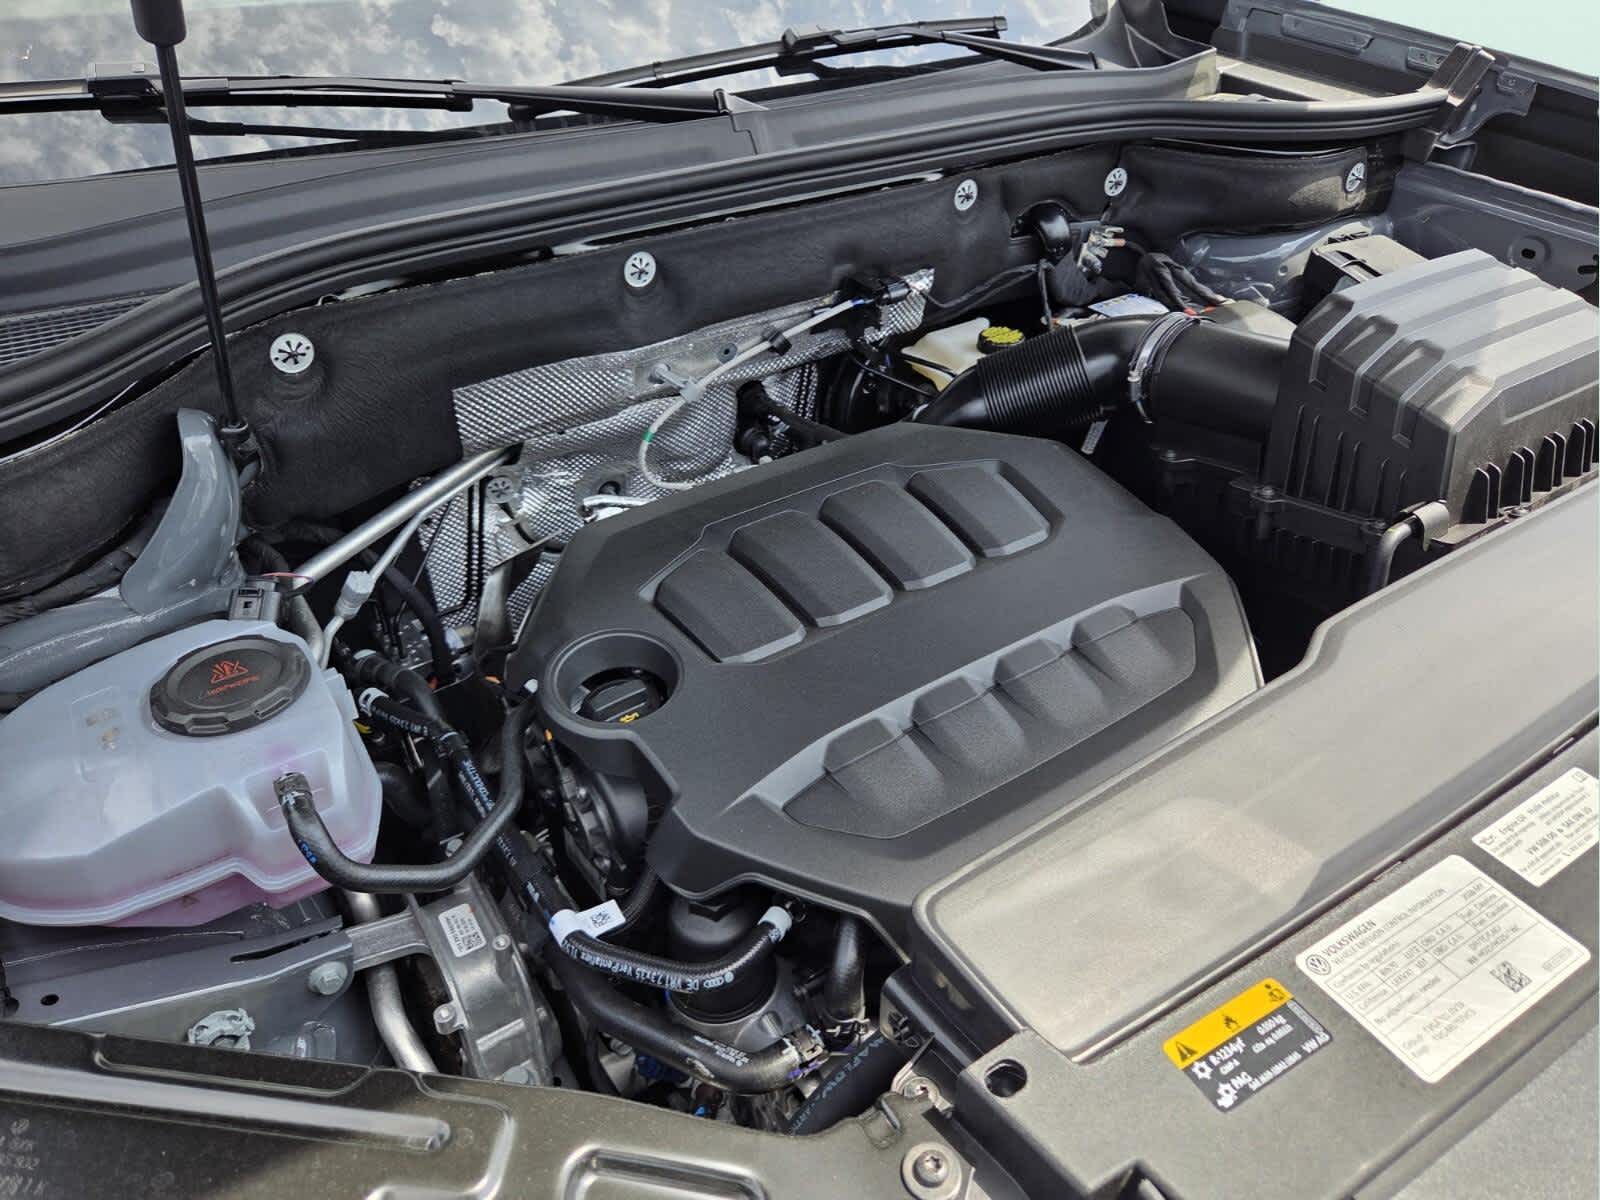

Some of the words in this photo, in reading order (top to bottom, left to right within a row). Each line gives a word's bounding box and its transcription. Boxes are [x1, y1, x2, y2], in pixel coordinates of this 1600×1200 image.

[1320, 918, 1377, 958] VOLKSWAGEN
[1206, 1036, 1250, 1068] R-1234yf
[1300, 1037, 1320, 1053] VW
